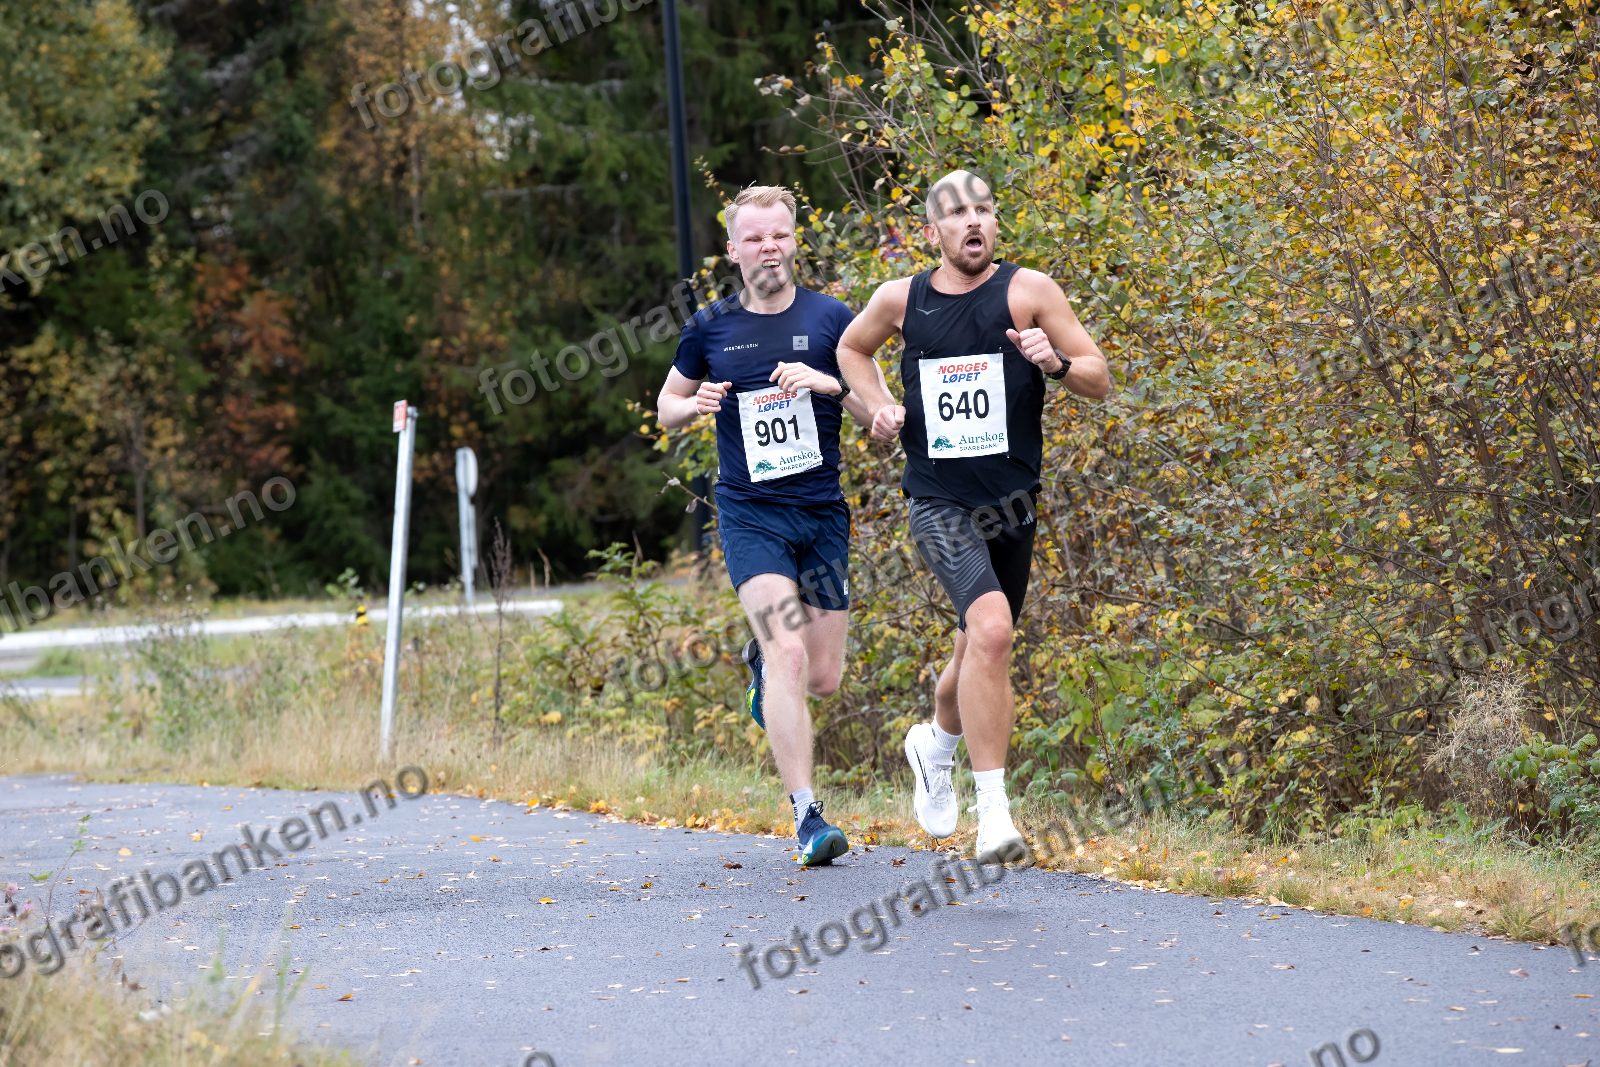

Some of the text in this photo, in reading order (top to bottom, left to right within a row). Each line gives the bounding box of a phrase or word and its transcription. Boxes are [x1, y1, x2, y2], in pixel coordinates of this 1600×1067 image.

[938, 362, 988, 374] NORGES
[942, 372, 981, 383] LØPET
[754, 390, 798, 405] NORGES
[758, 399, 792, 413] LØPET
[938, 389, 990, 421] 640
[755, 415, 801, 447] 901
[959, 432, 1005, 444] Aurskog
